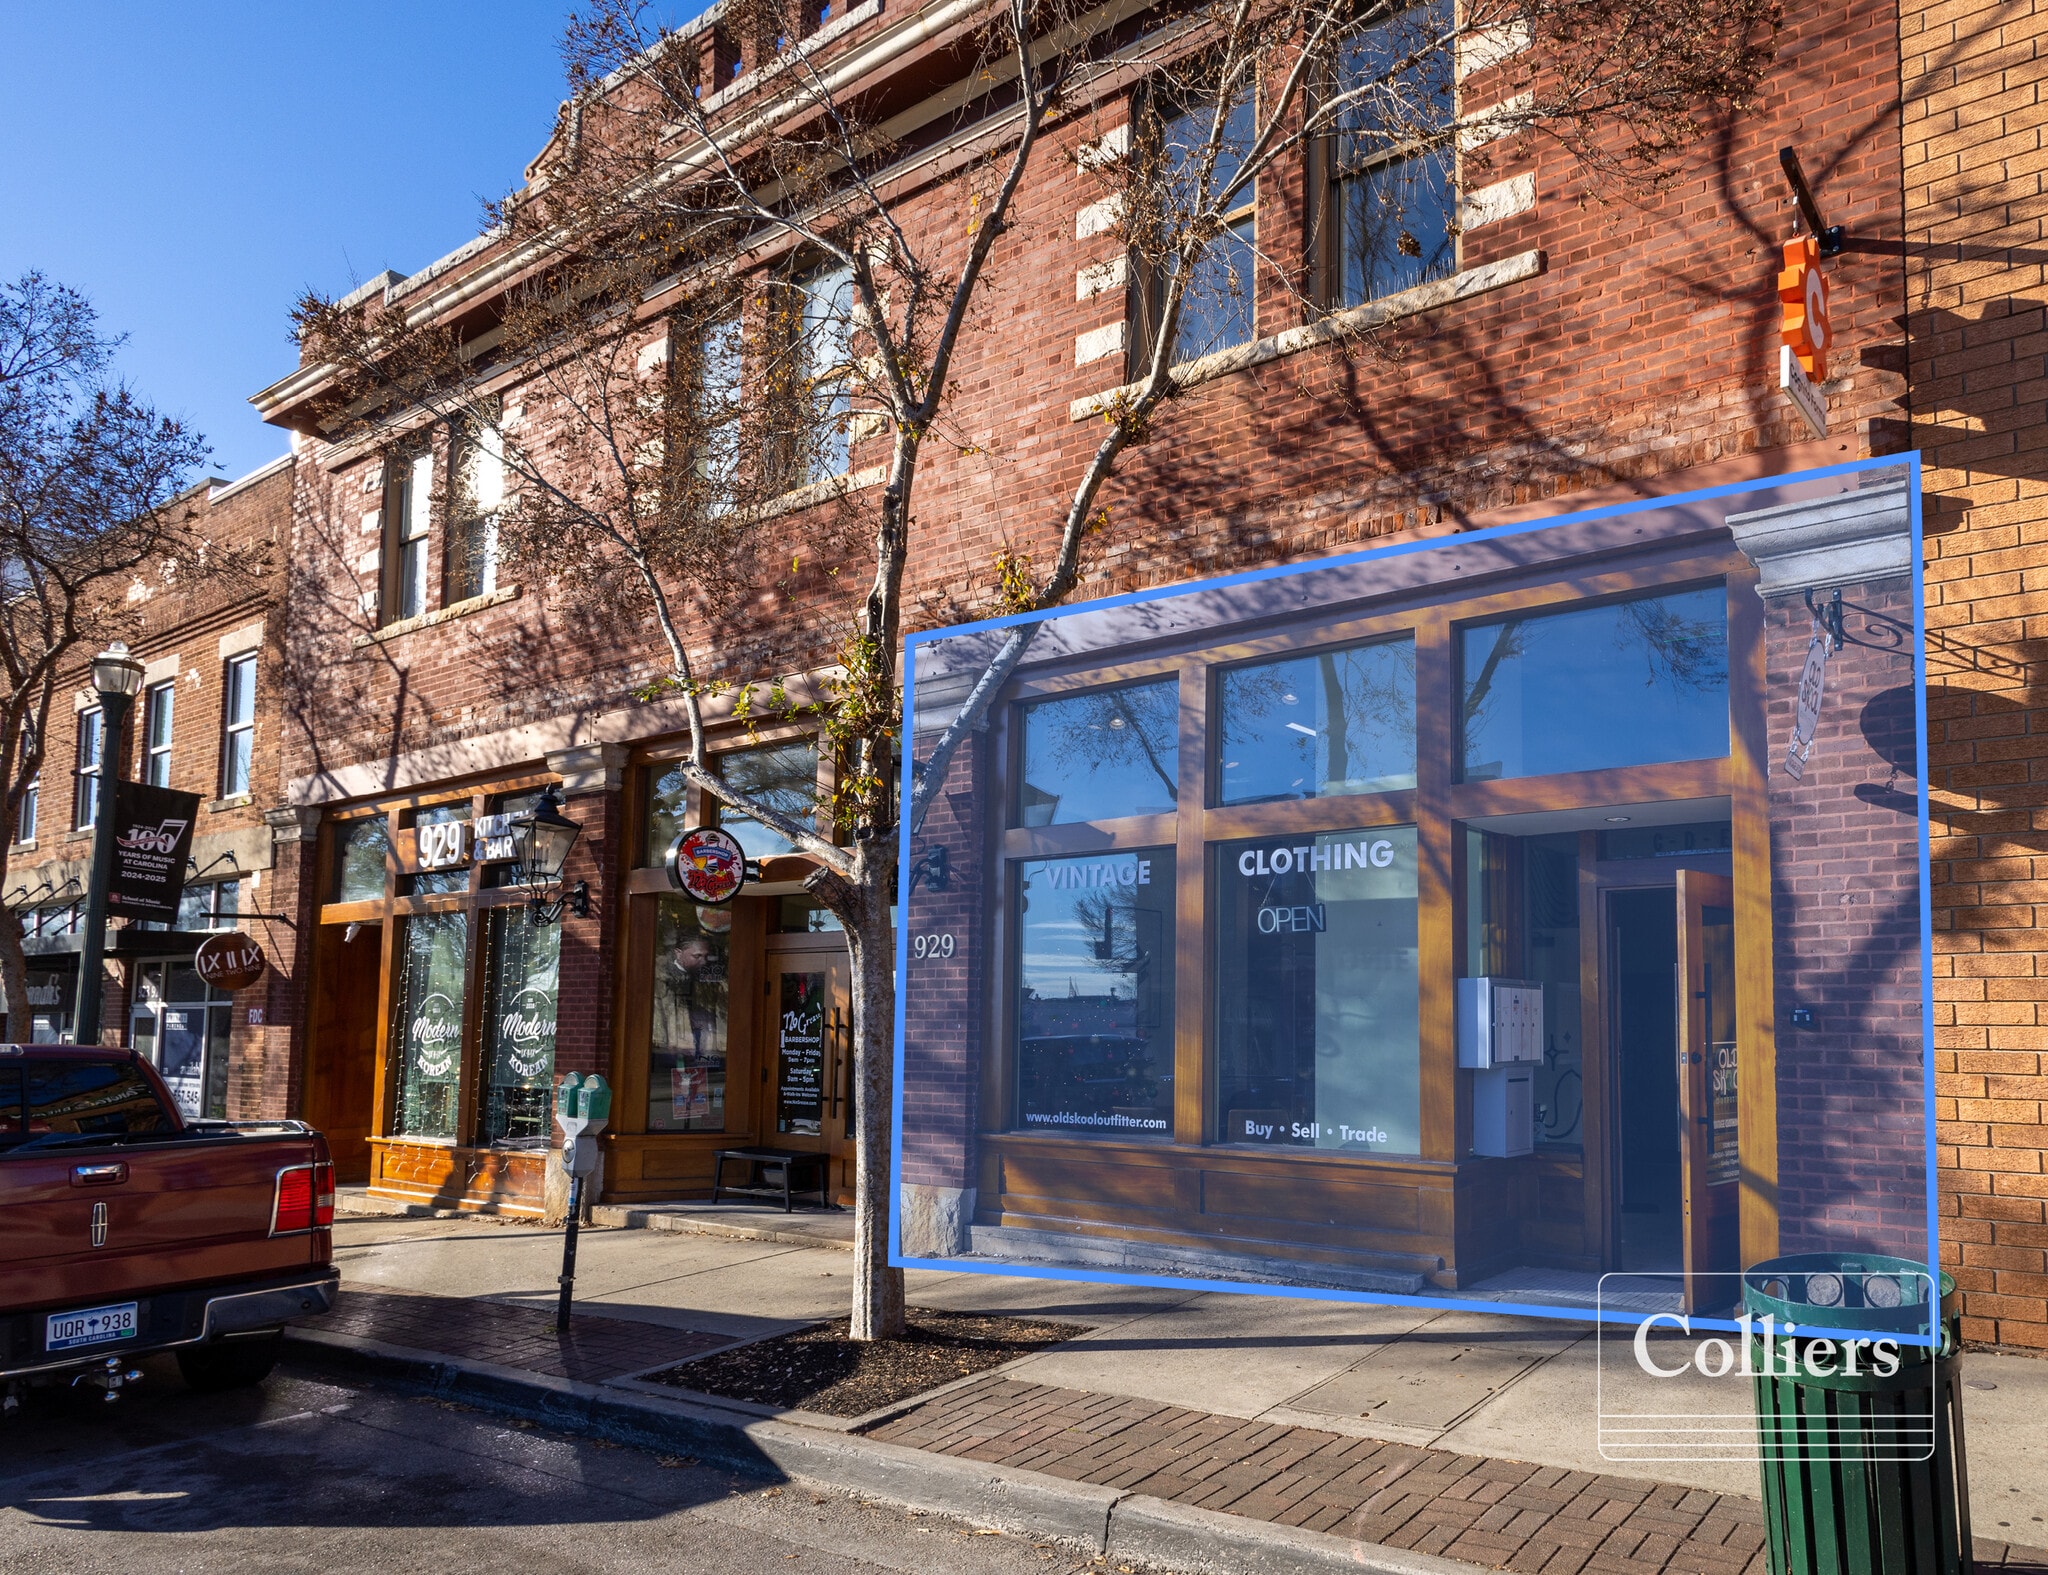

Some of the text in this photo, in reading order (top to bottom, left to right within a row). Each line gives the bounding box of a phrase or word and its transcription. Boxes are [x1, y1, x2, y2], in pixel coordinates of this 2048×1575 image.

[419, 821, 465, 868] 929
[473, 836, 516, 861] & BAR
[696, 847, 729, 858] BARBERSHOP
[118, 850, 141, 859] YEARS
[152, 855, 176, 864] MUSIC
[132, 859, 168, 870] CAROLINA
[1238, 839, 1395, 877] CLOTHING
[121, 870, 167, 883] 2024-2025
[1045, 861, 1151, 889] VINTAGE
[1258, 905, 1325, 934] OPEN
[914, 933, 955, 959] 929
[200, 945, 260, 974] IX II IX
[206, 963, 262, 979] NINE TWO NINE
[248, 1008, 263, 1023] FDC
[502, 1012, 557, 1042] Modern
[412, 1016, 460, 1044] Modern
[508, 1053, 549, 1077] KOREAN
[805, 1049, 821, 1057] Friday
[417, 1054, 453, 1077] KOREAN
[790, 1067, 812, 1075] Saturday
[1026, 1112, 1167, 1129] www.oldskooloutfitter.com
[1245, 1119, 1388, 1143] Buy Sell Trade
[54, 1312, 131, 1339] UQR 938
[68, 1337, 88, 1345] SOUTH
[88, 1332, 116, 1342] CAROLINA
